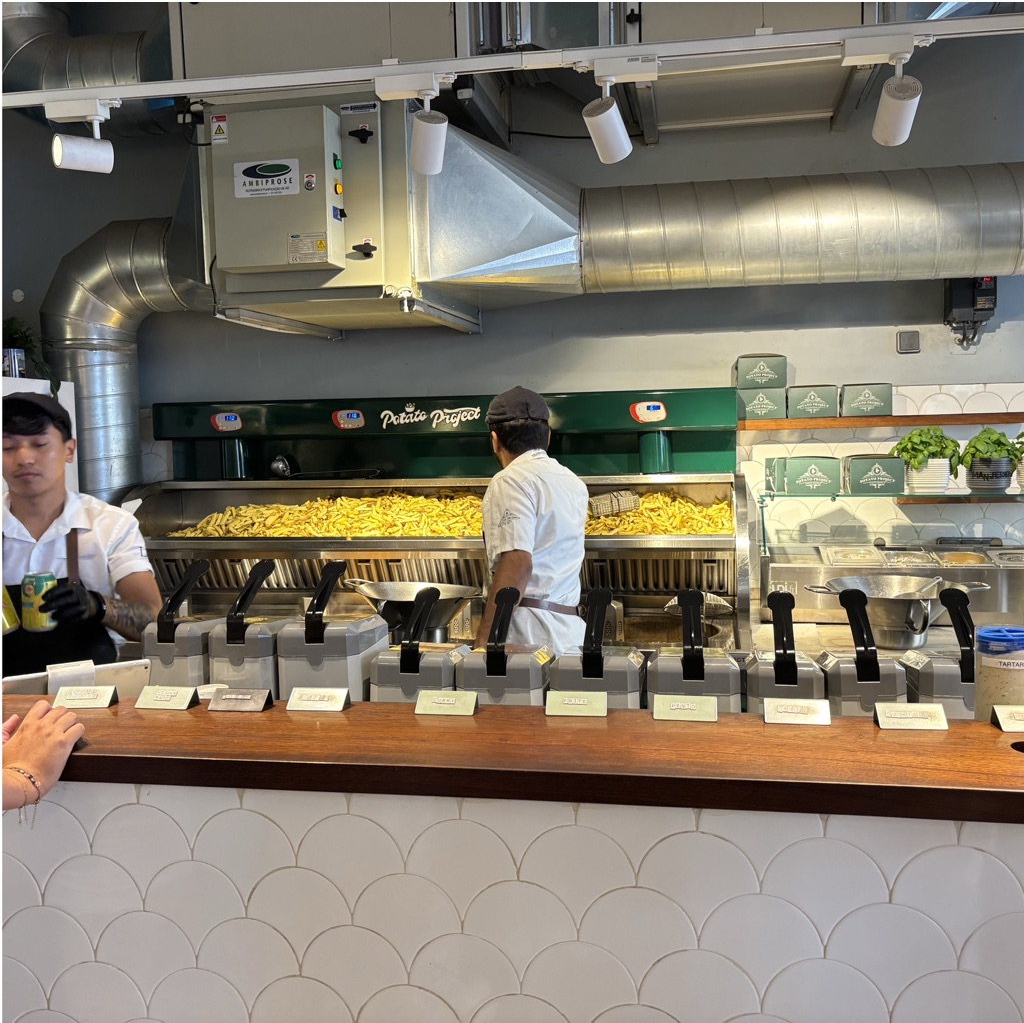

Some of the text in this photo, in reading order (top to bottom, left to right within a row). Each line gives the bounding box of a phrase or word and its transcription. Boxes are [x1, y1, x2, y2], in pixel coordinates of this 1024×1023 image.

[243, 178, 292, 187] AMBIPROSE
[380, 407, 481, 429] Potato Project
